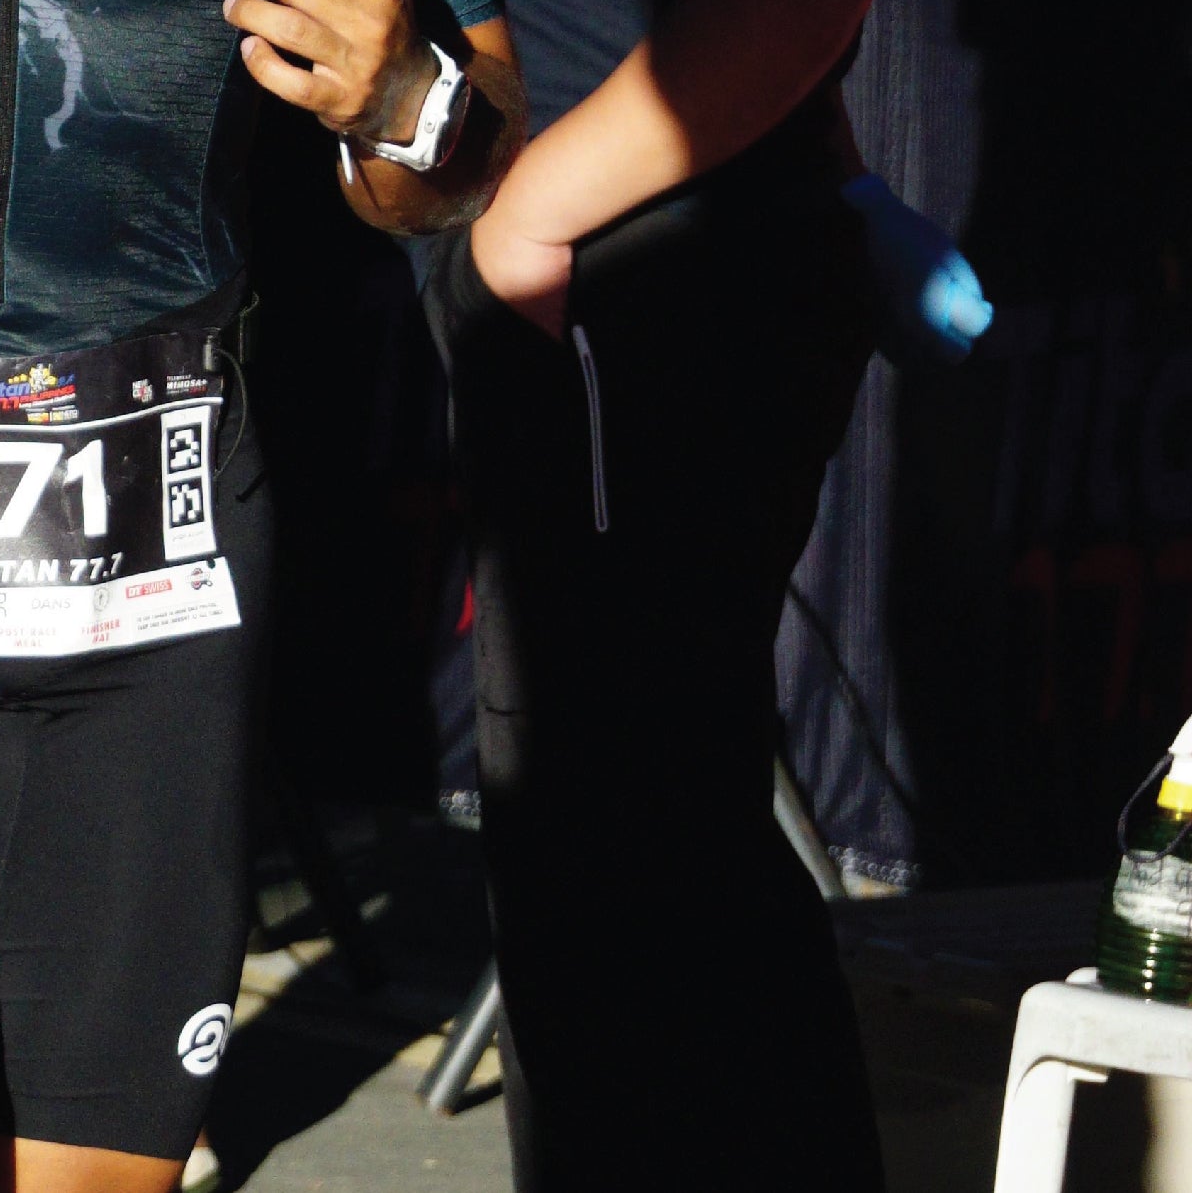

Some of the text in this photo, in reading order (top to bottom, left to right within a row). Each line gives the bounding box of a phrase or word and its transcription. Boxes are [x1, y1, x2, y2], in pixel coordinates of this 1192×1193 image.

[67, 551, 124, 584] 77.7
[142, 580, 171, 595] SWISS
[81, 618, 121, 635] FINISHER
